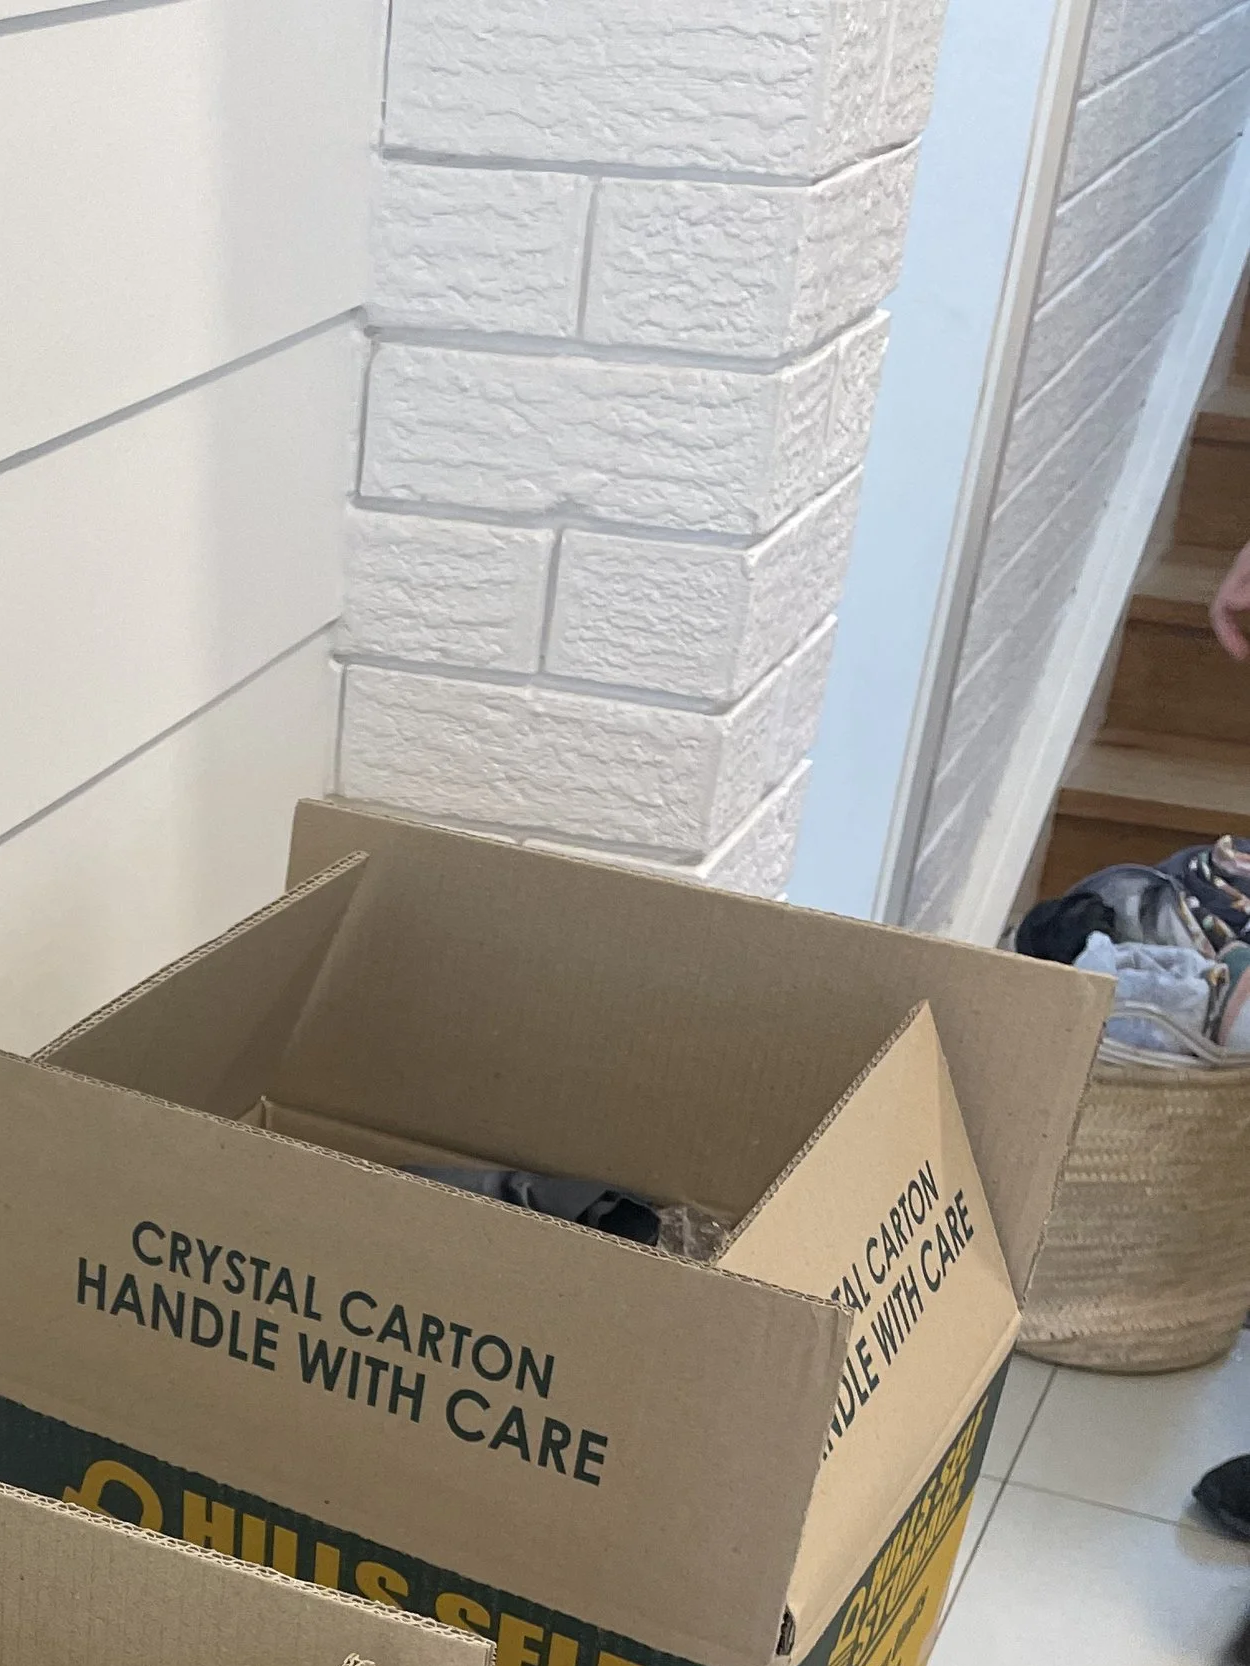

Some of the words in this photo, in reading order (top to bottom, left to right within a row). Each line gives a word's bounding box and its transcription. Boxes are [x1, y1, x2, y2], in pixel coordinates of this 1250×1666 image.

[132, 1221, 322, 1322] CRYSTAL
[339, 1291, 555, 1399] CARTON
[866, 1160, 939, 1284] CARTON
[871, 1265, 925, 1367] WITH
[921, 1188, 974, 1293] CARE
[76, 1257, 279, 1371] HANDLE
[298, 1332, 425, 1423] WITH
[445, 1389, 608, 1486] CARE
